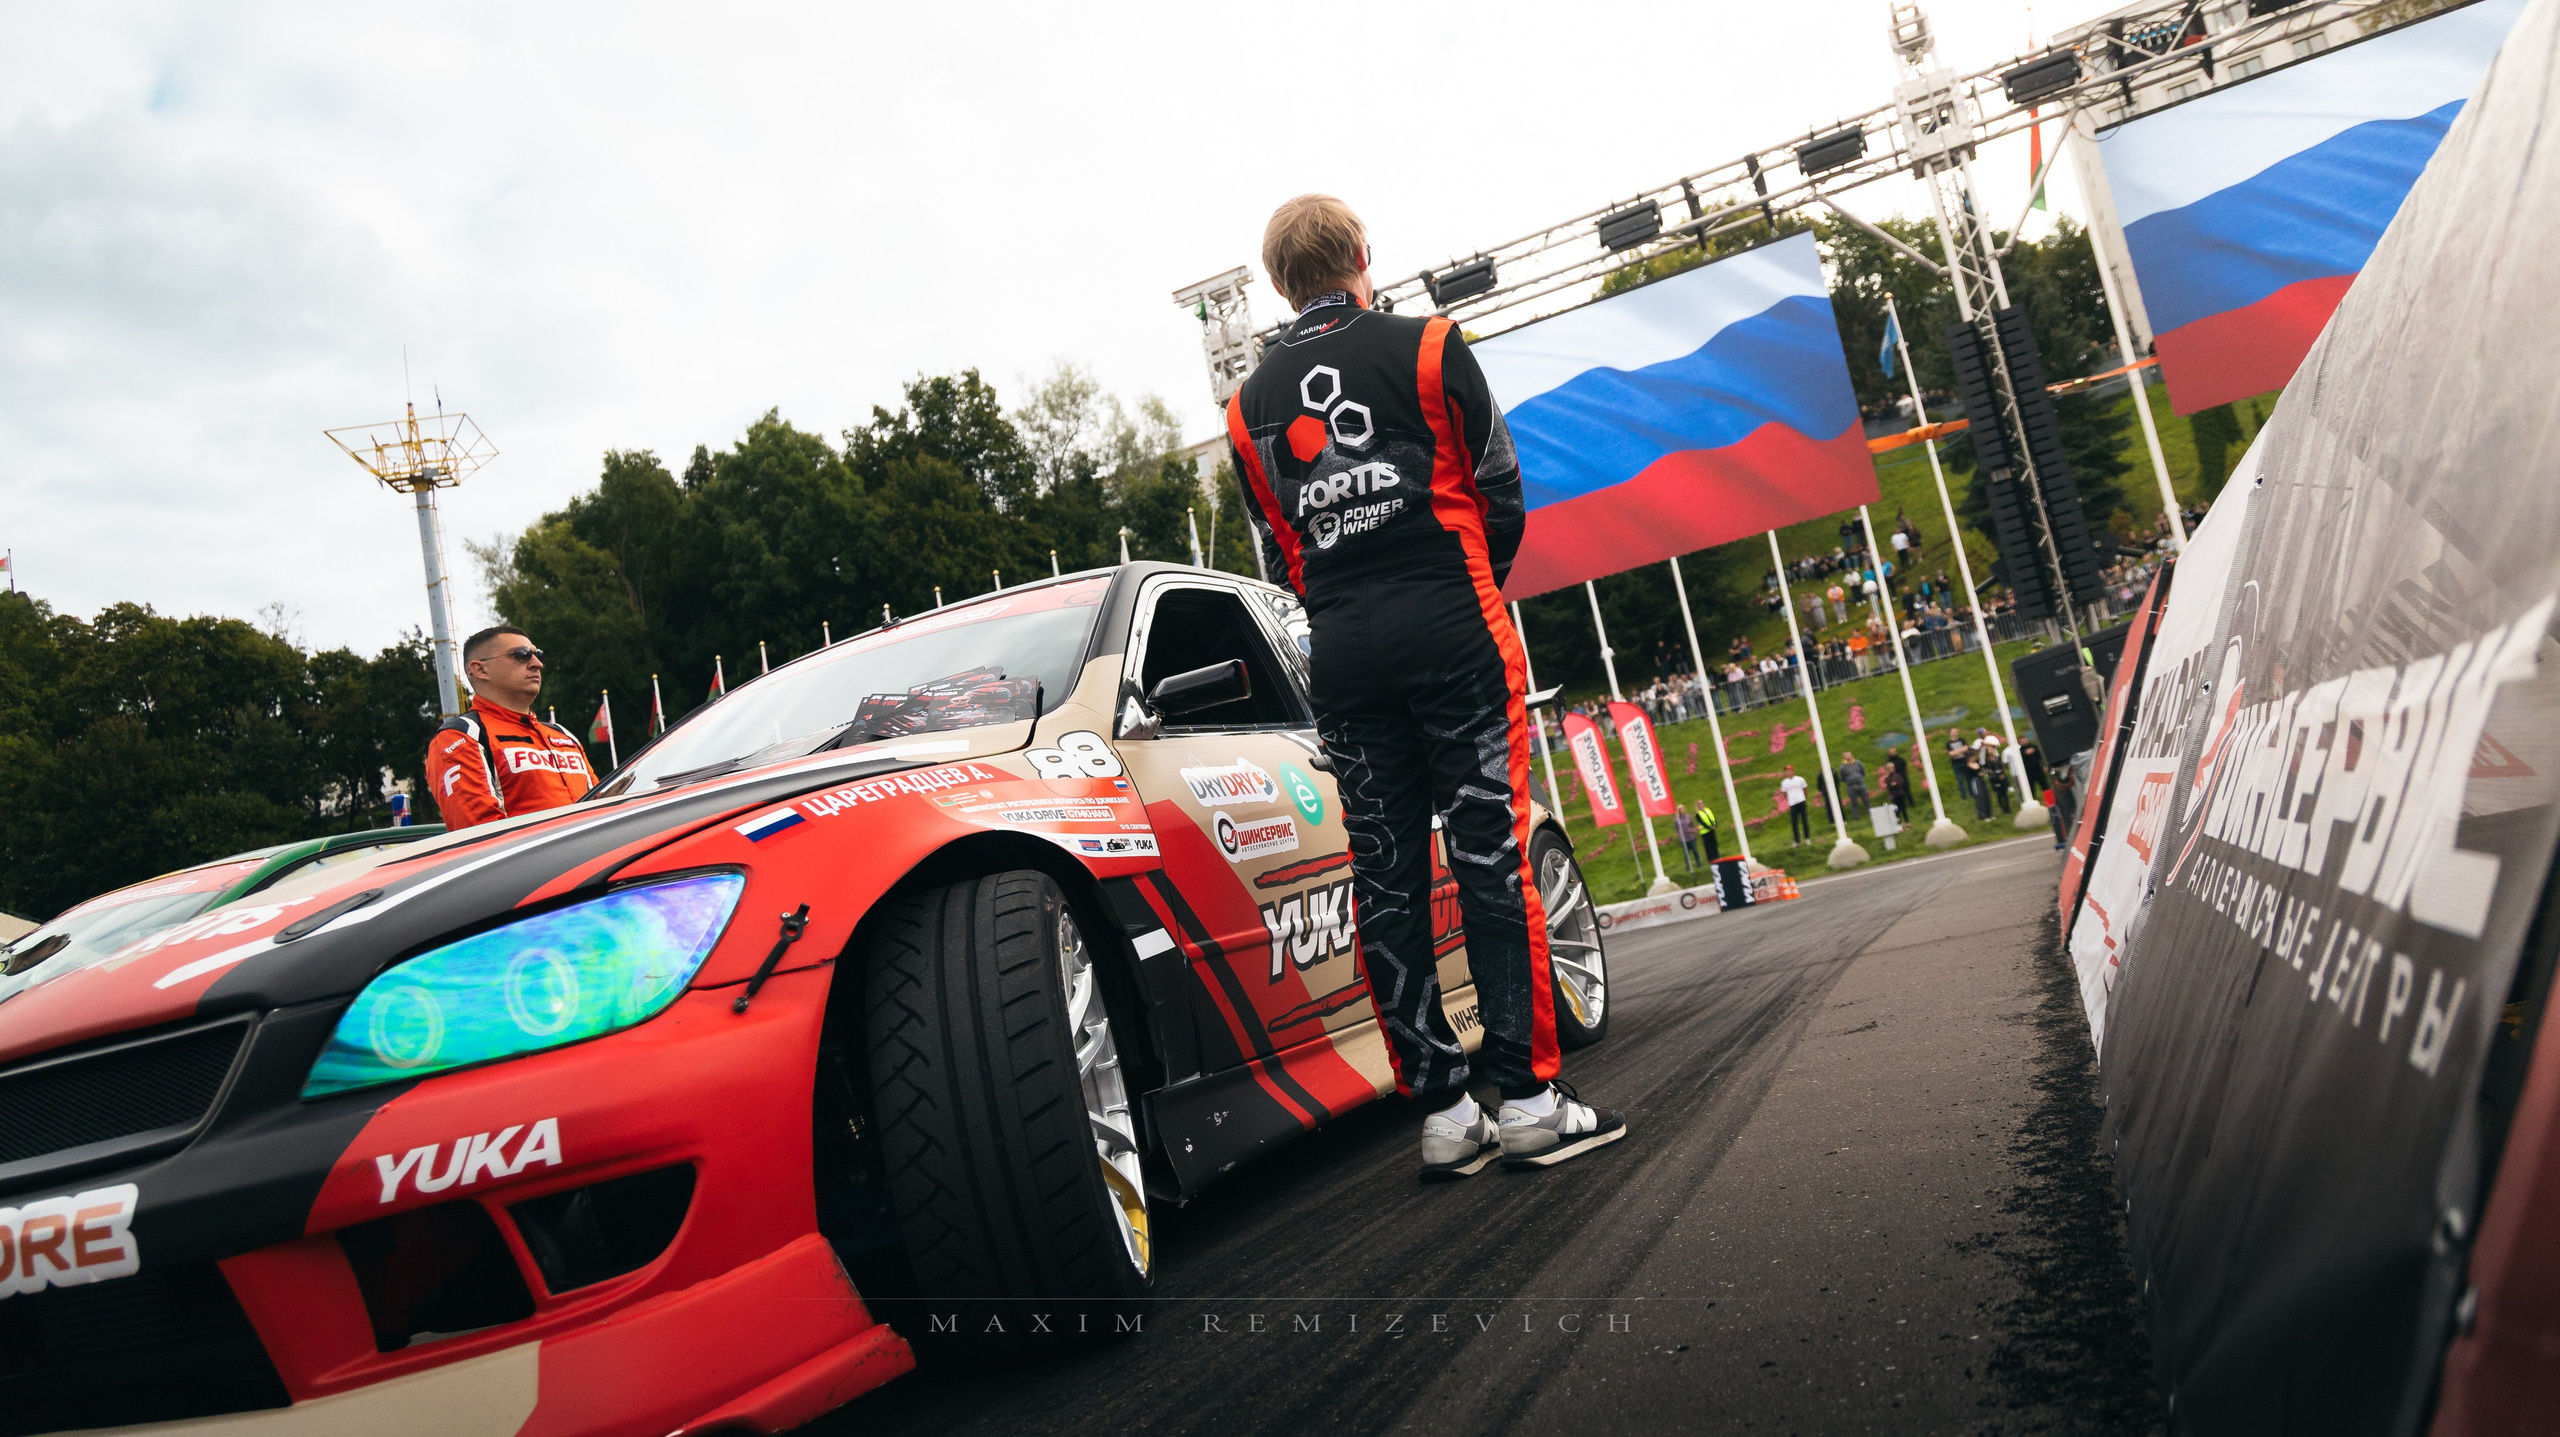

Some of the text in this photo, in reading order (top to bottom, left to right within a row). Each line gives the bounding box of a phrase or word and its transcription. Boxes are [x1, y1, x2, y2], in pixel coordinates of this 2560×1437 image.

[1298, 461, 1400, 518] FORTIS
[1343, 498, 1404, 522] POWER
[515, 750, 585, 770] FONBET
[1023, 730, 1123, 779] 88
[801, 767, 970, 818] ЦАРЕГРАДЦЕВ
[1189, 772, 1257, 799] DRYDRY
[1002, 808, 1112, 822] YUKA DRIVE GYMKHANA
[1134, 839, 1154, 850] YUKA
[1237, 822, 1294, 847] ШИНСЕРВИС
[376, 1117, 563, 1204] YUKA
